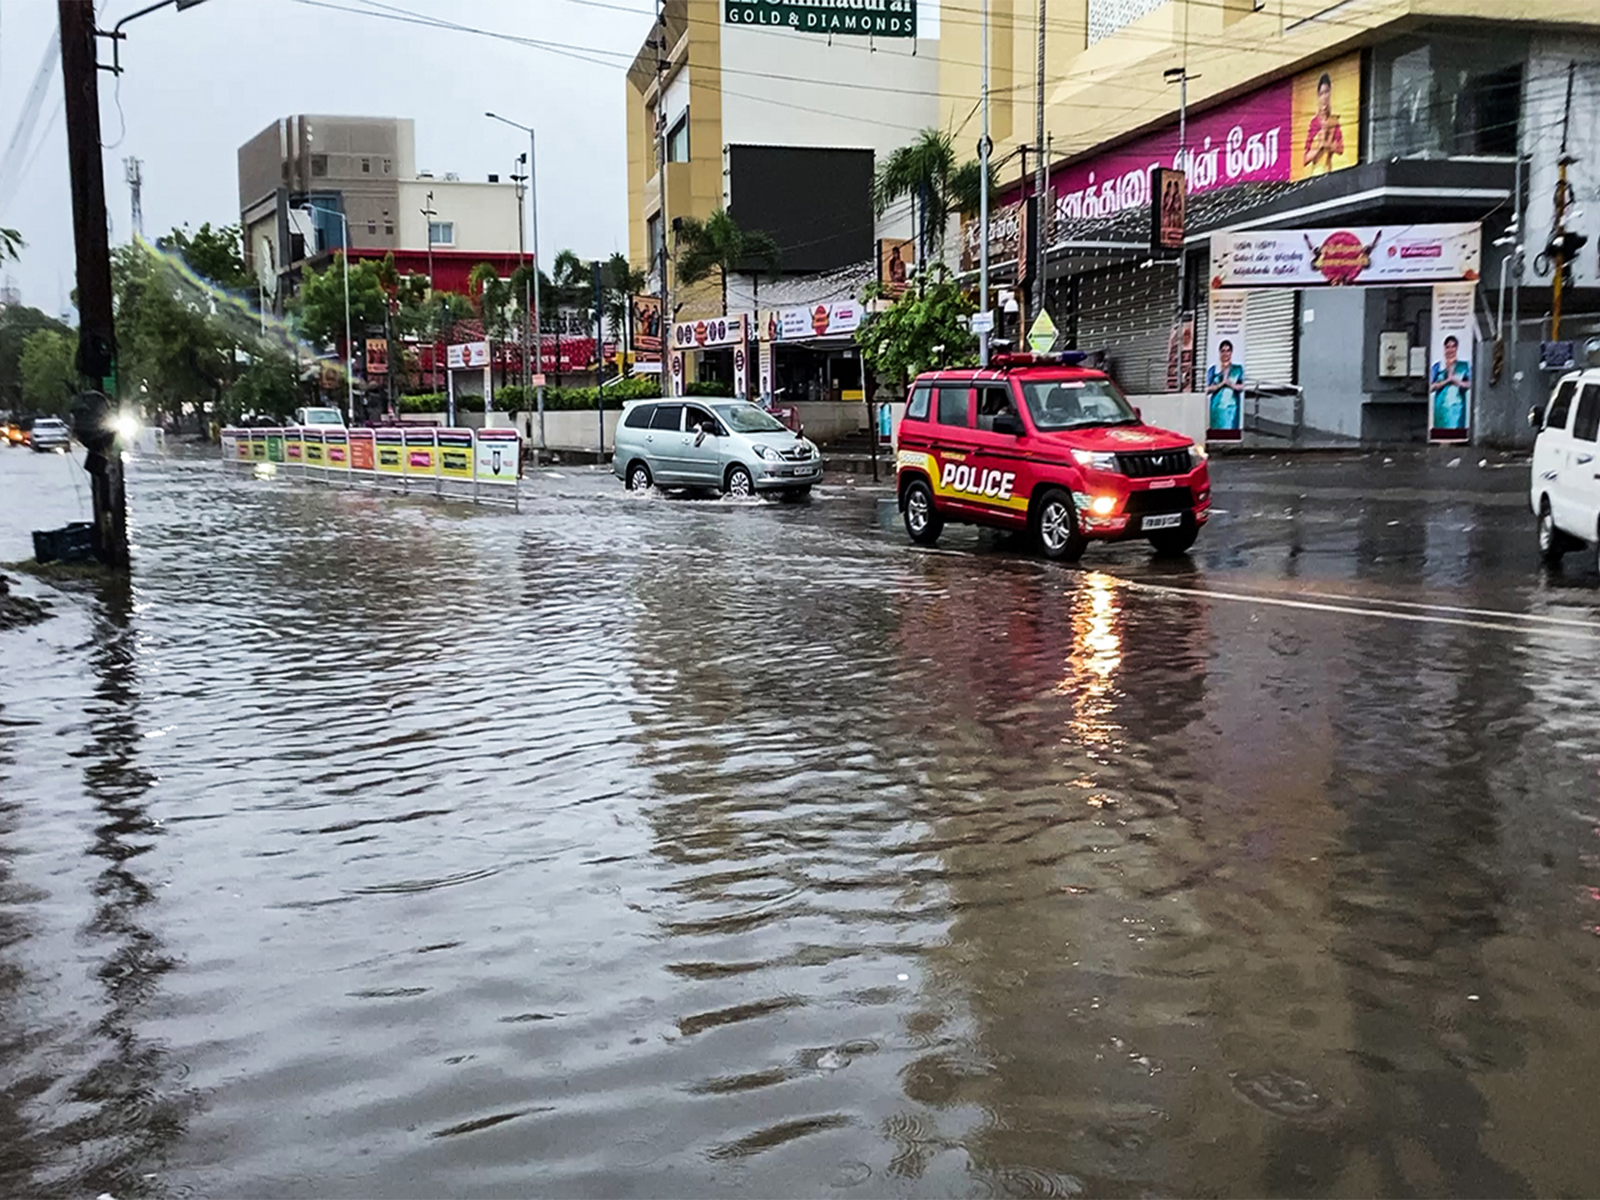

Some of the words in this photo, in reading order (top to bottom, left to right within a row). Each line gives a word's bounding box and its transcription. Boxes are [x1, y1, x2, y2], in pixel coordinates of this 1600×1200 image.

[729, 9, 781, 24] GOLD
[788, 12, 800, 26] &
[807, 13, 913, 32] DIAMONDS
[1226, 126, 1281, 178] கோ
[940, 462, 1016, 500] POLICE
